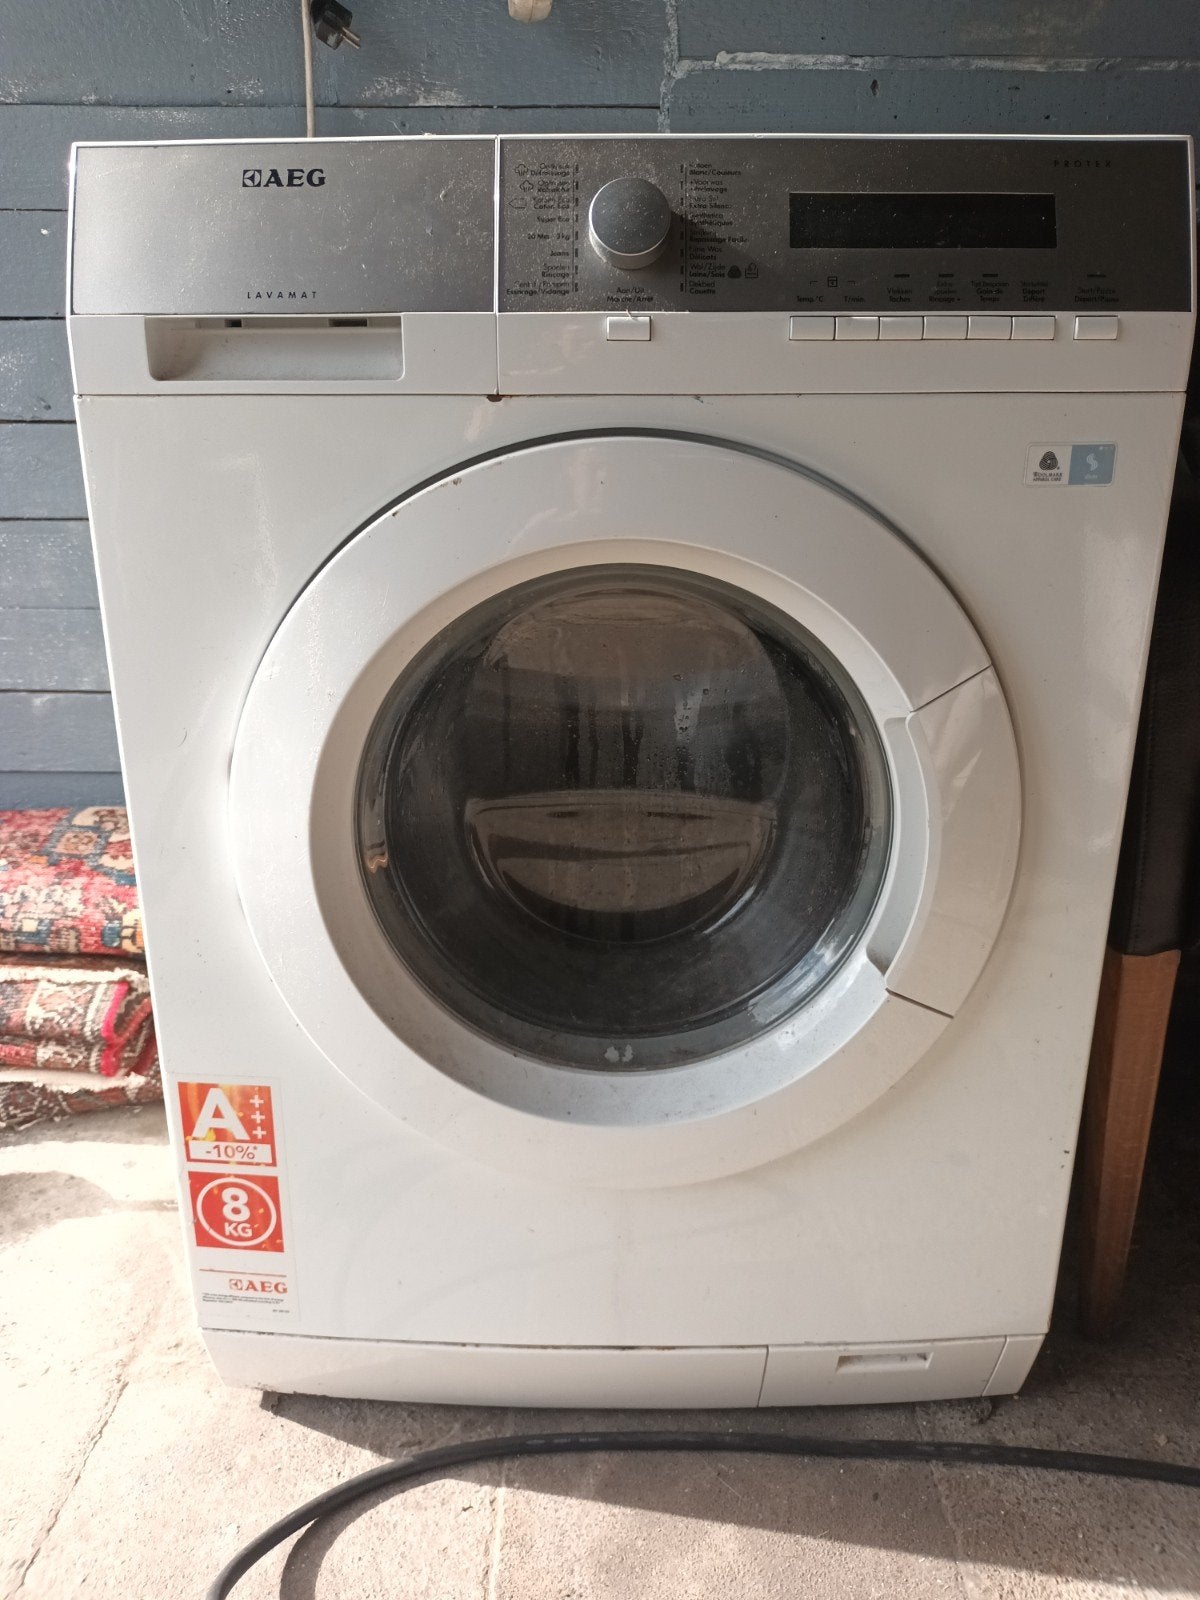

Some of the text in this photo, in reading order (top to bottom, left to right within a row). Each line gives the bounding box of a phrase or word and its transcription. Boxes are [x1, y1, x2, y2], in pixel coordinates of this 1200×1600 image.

[1053, 160, 1112, 168] PROTEX
[263, 168, 326, 188] AEG
[247, 291, 317, 299] LAVAMAT
[190, 1087, 251, 1141] A
[221, 1186, 251, 1222] 8
[224, 1221, 253, 1238] KG
[244, 1279, 288, 1294] AEG
